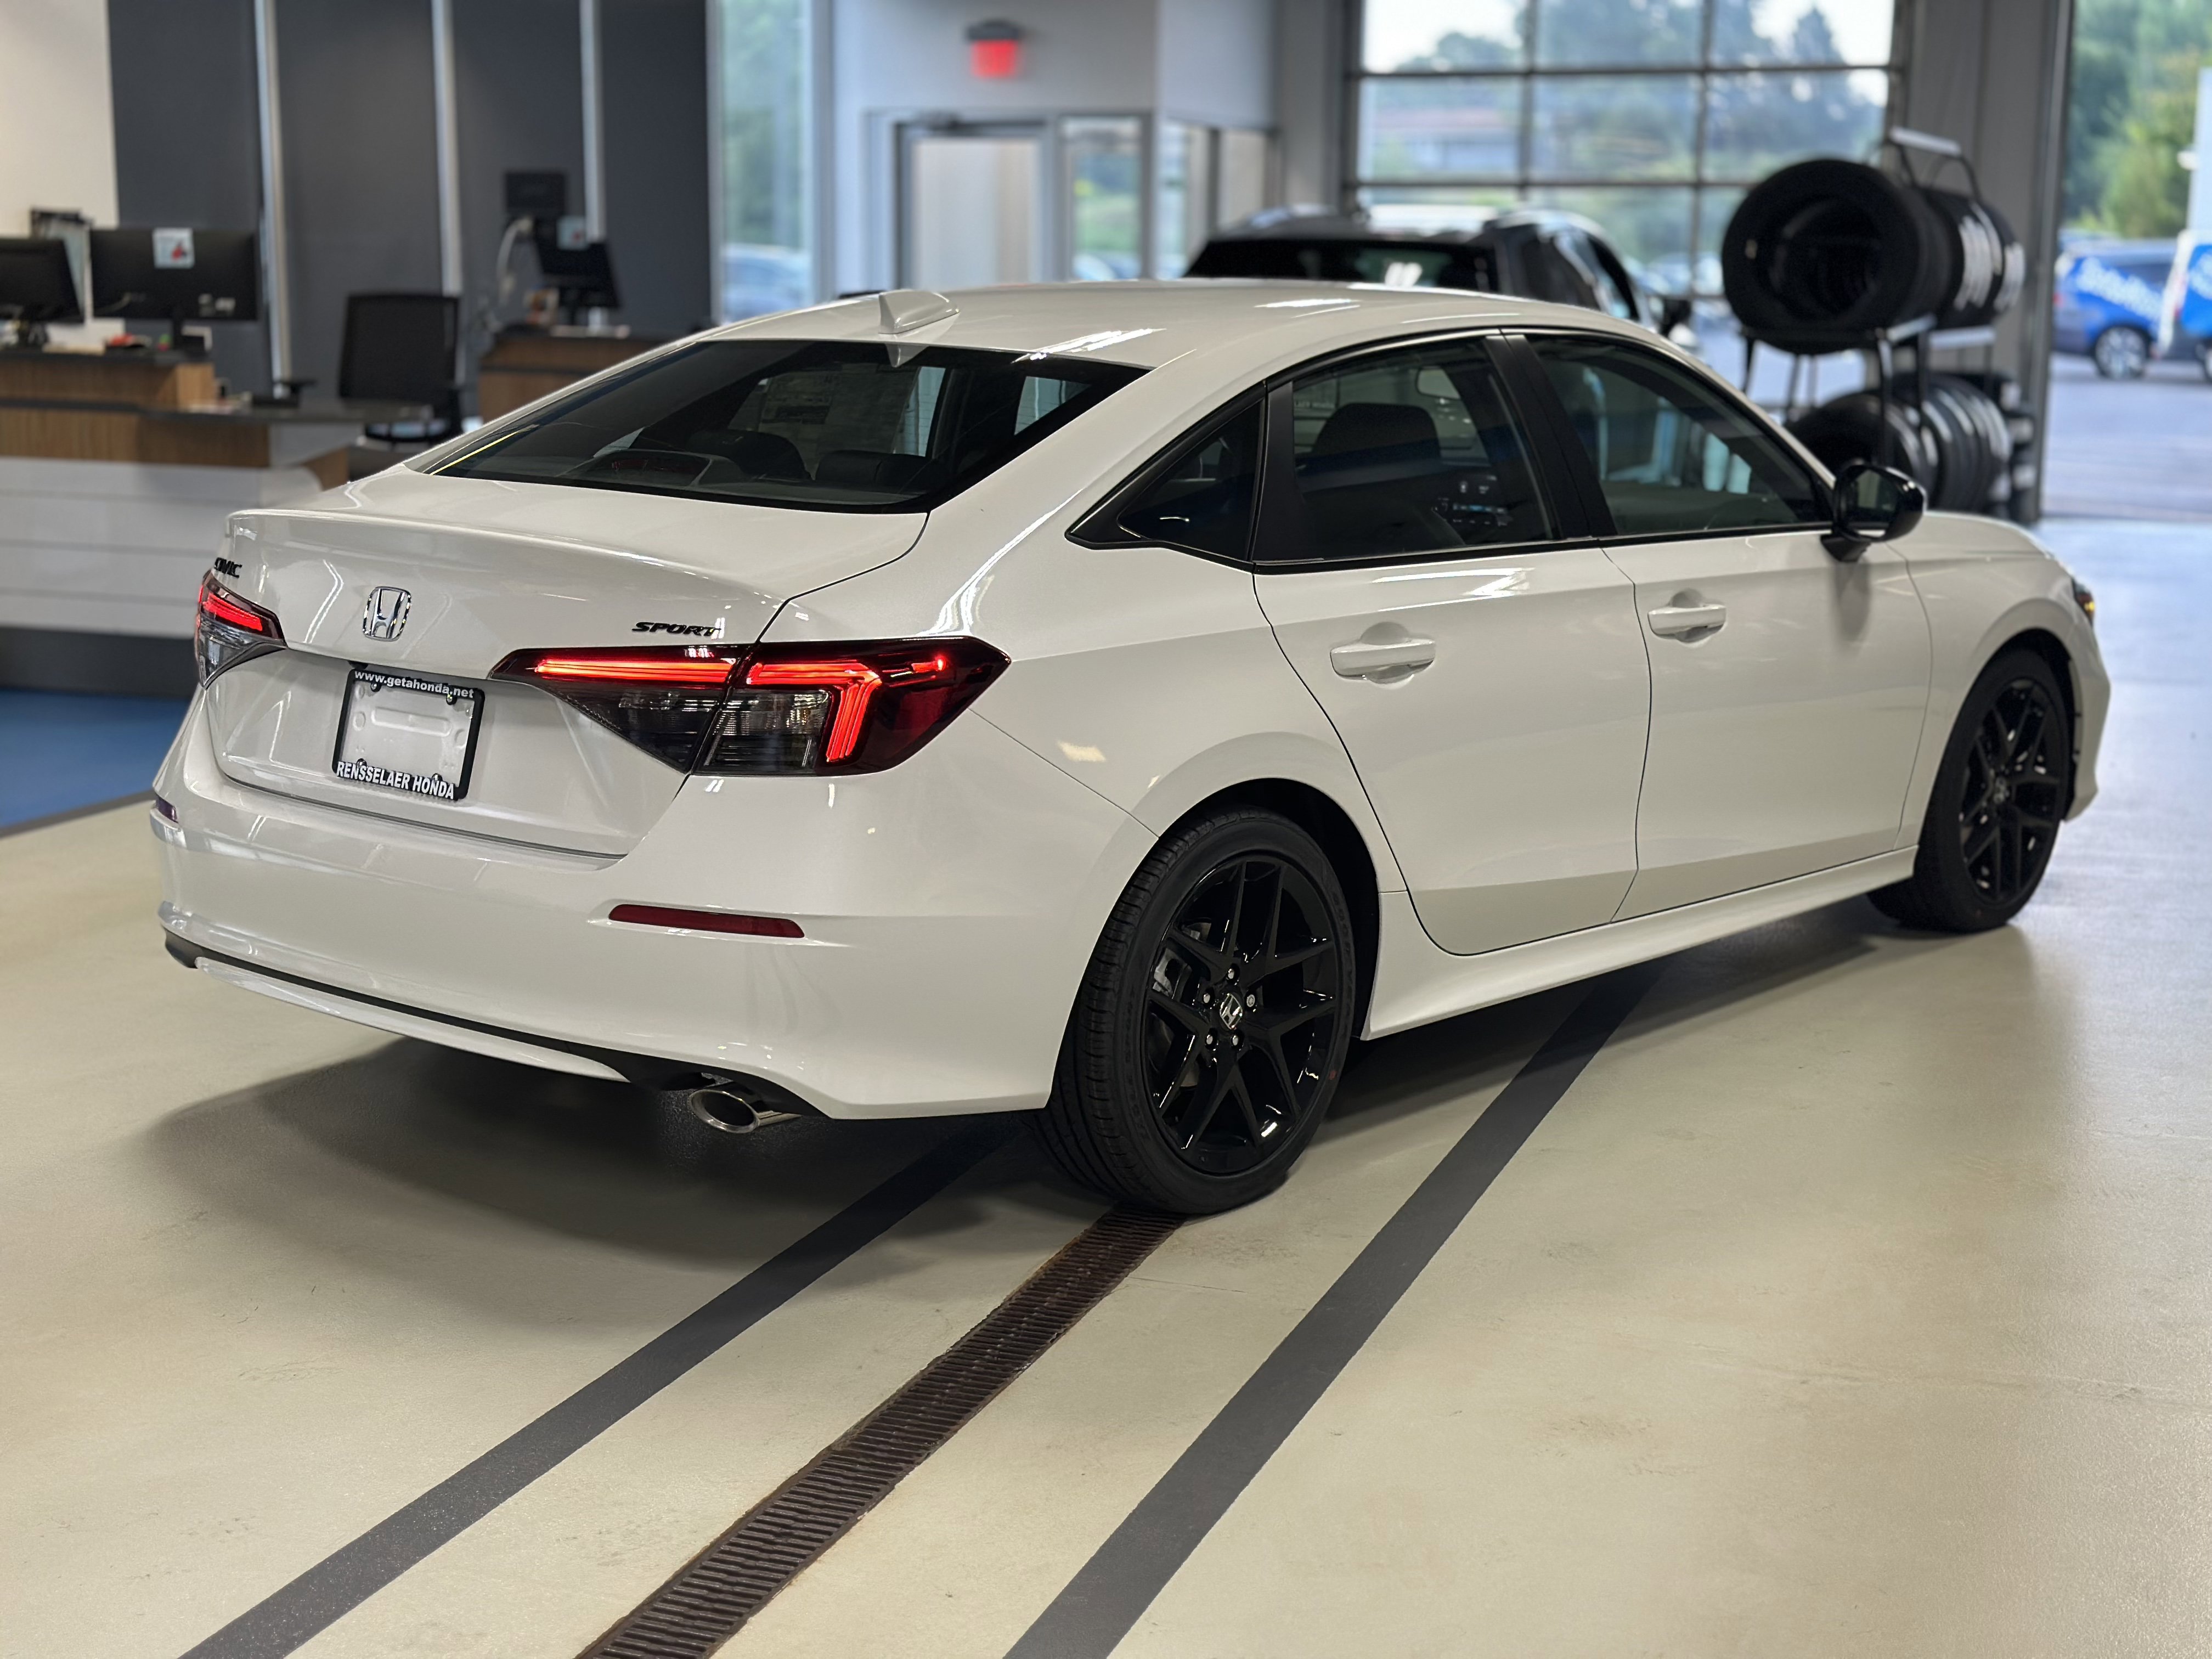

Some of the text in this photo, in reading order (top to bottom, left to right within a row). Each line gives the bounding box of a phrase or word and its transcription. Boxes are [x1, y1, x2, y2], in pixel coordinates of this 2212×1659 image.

[631, 622, 721, 637] SPORT
[354, 670, 475, 698] www.getahonda.net
[336, 761, 455, 799] RENSSELAER HONDA
